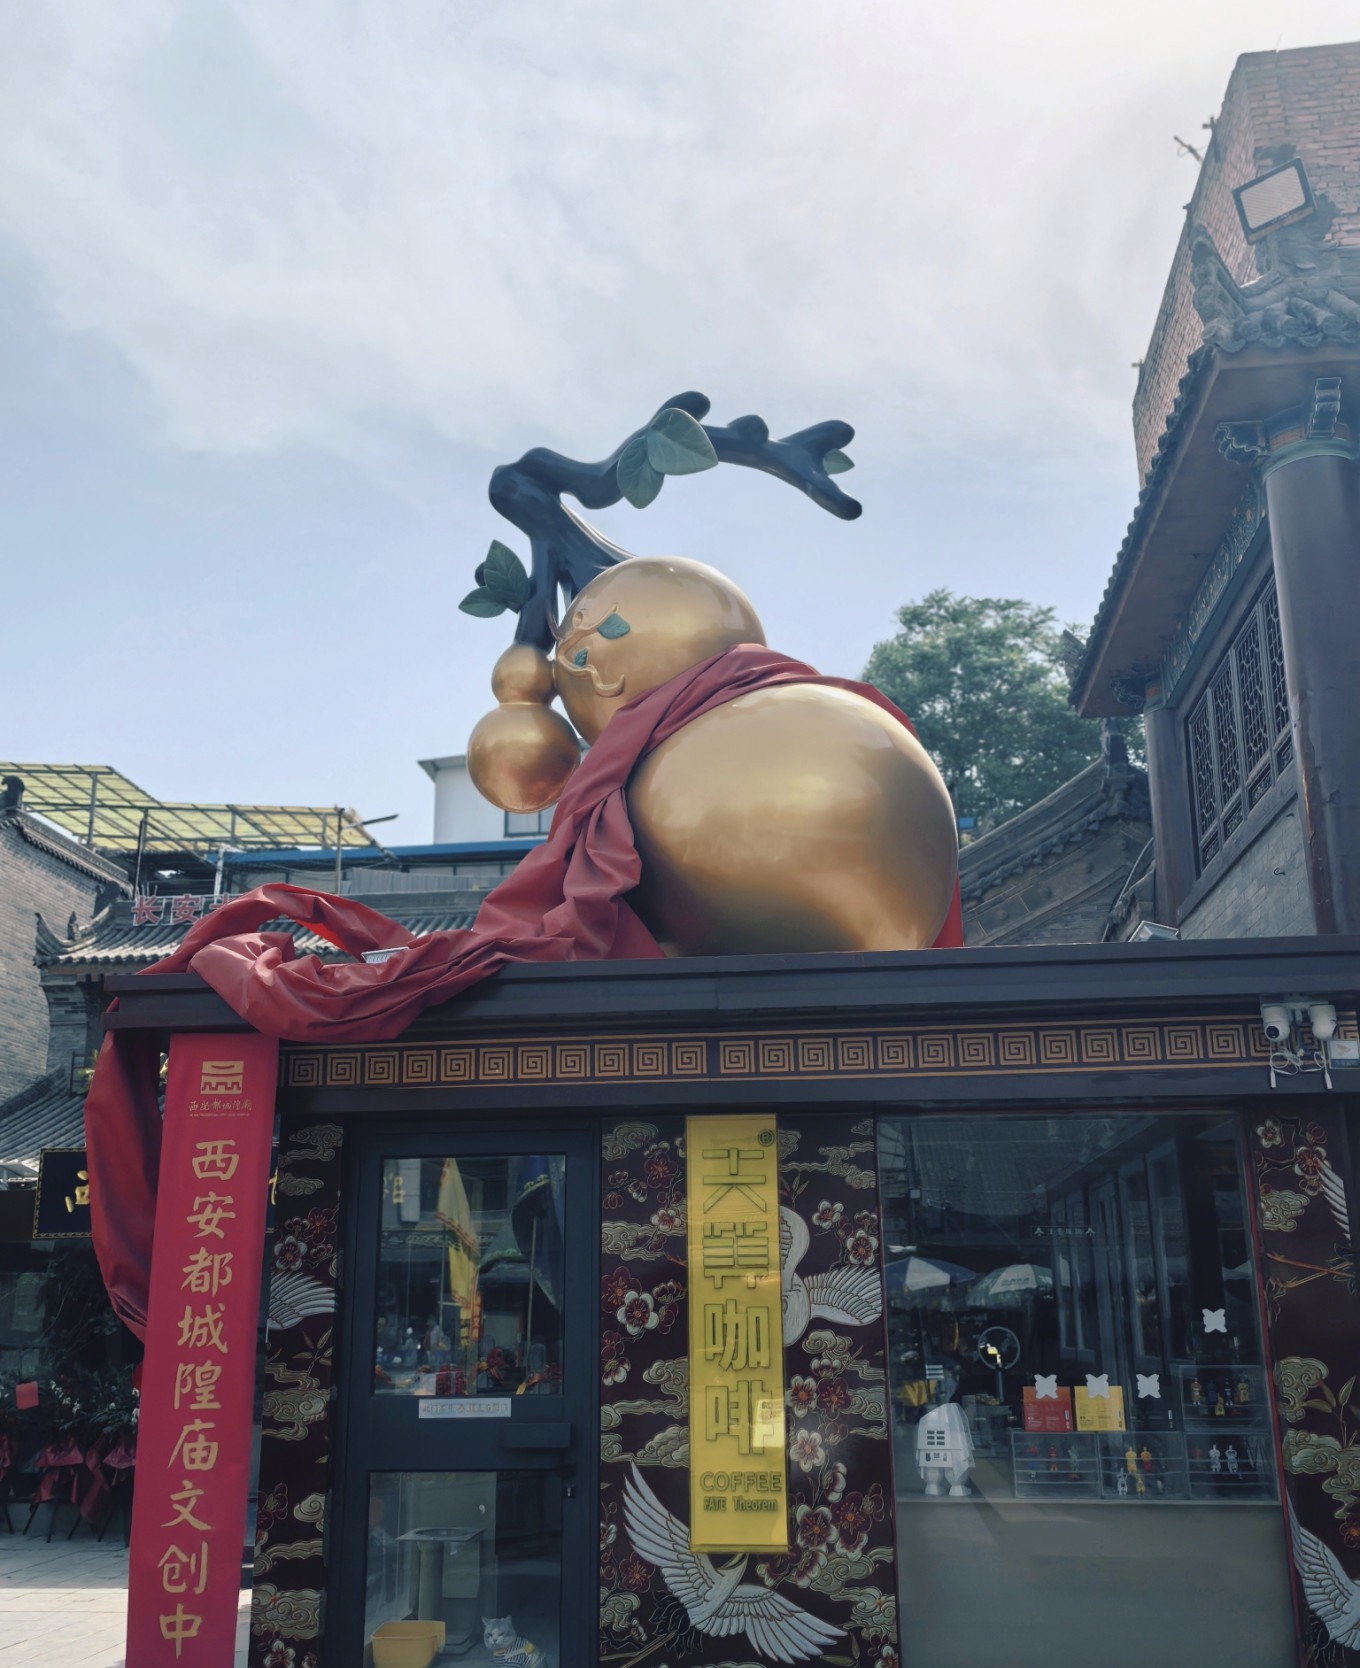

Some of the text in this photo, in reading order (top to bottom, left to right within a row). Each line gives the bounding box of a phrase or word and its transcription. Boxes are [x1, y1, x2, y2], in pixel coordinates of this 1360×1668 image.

[157, 1140, 237, 1659] 西安都城隍庙文创中
[699, 1471, 783, 1492] COFFEE
[703, 1494, 778, 1512] FATE Theorem
